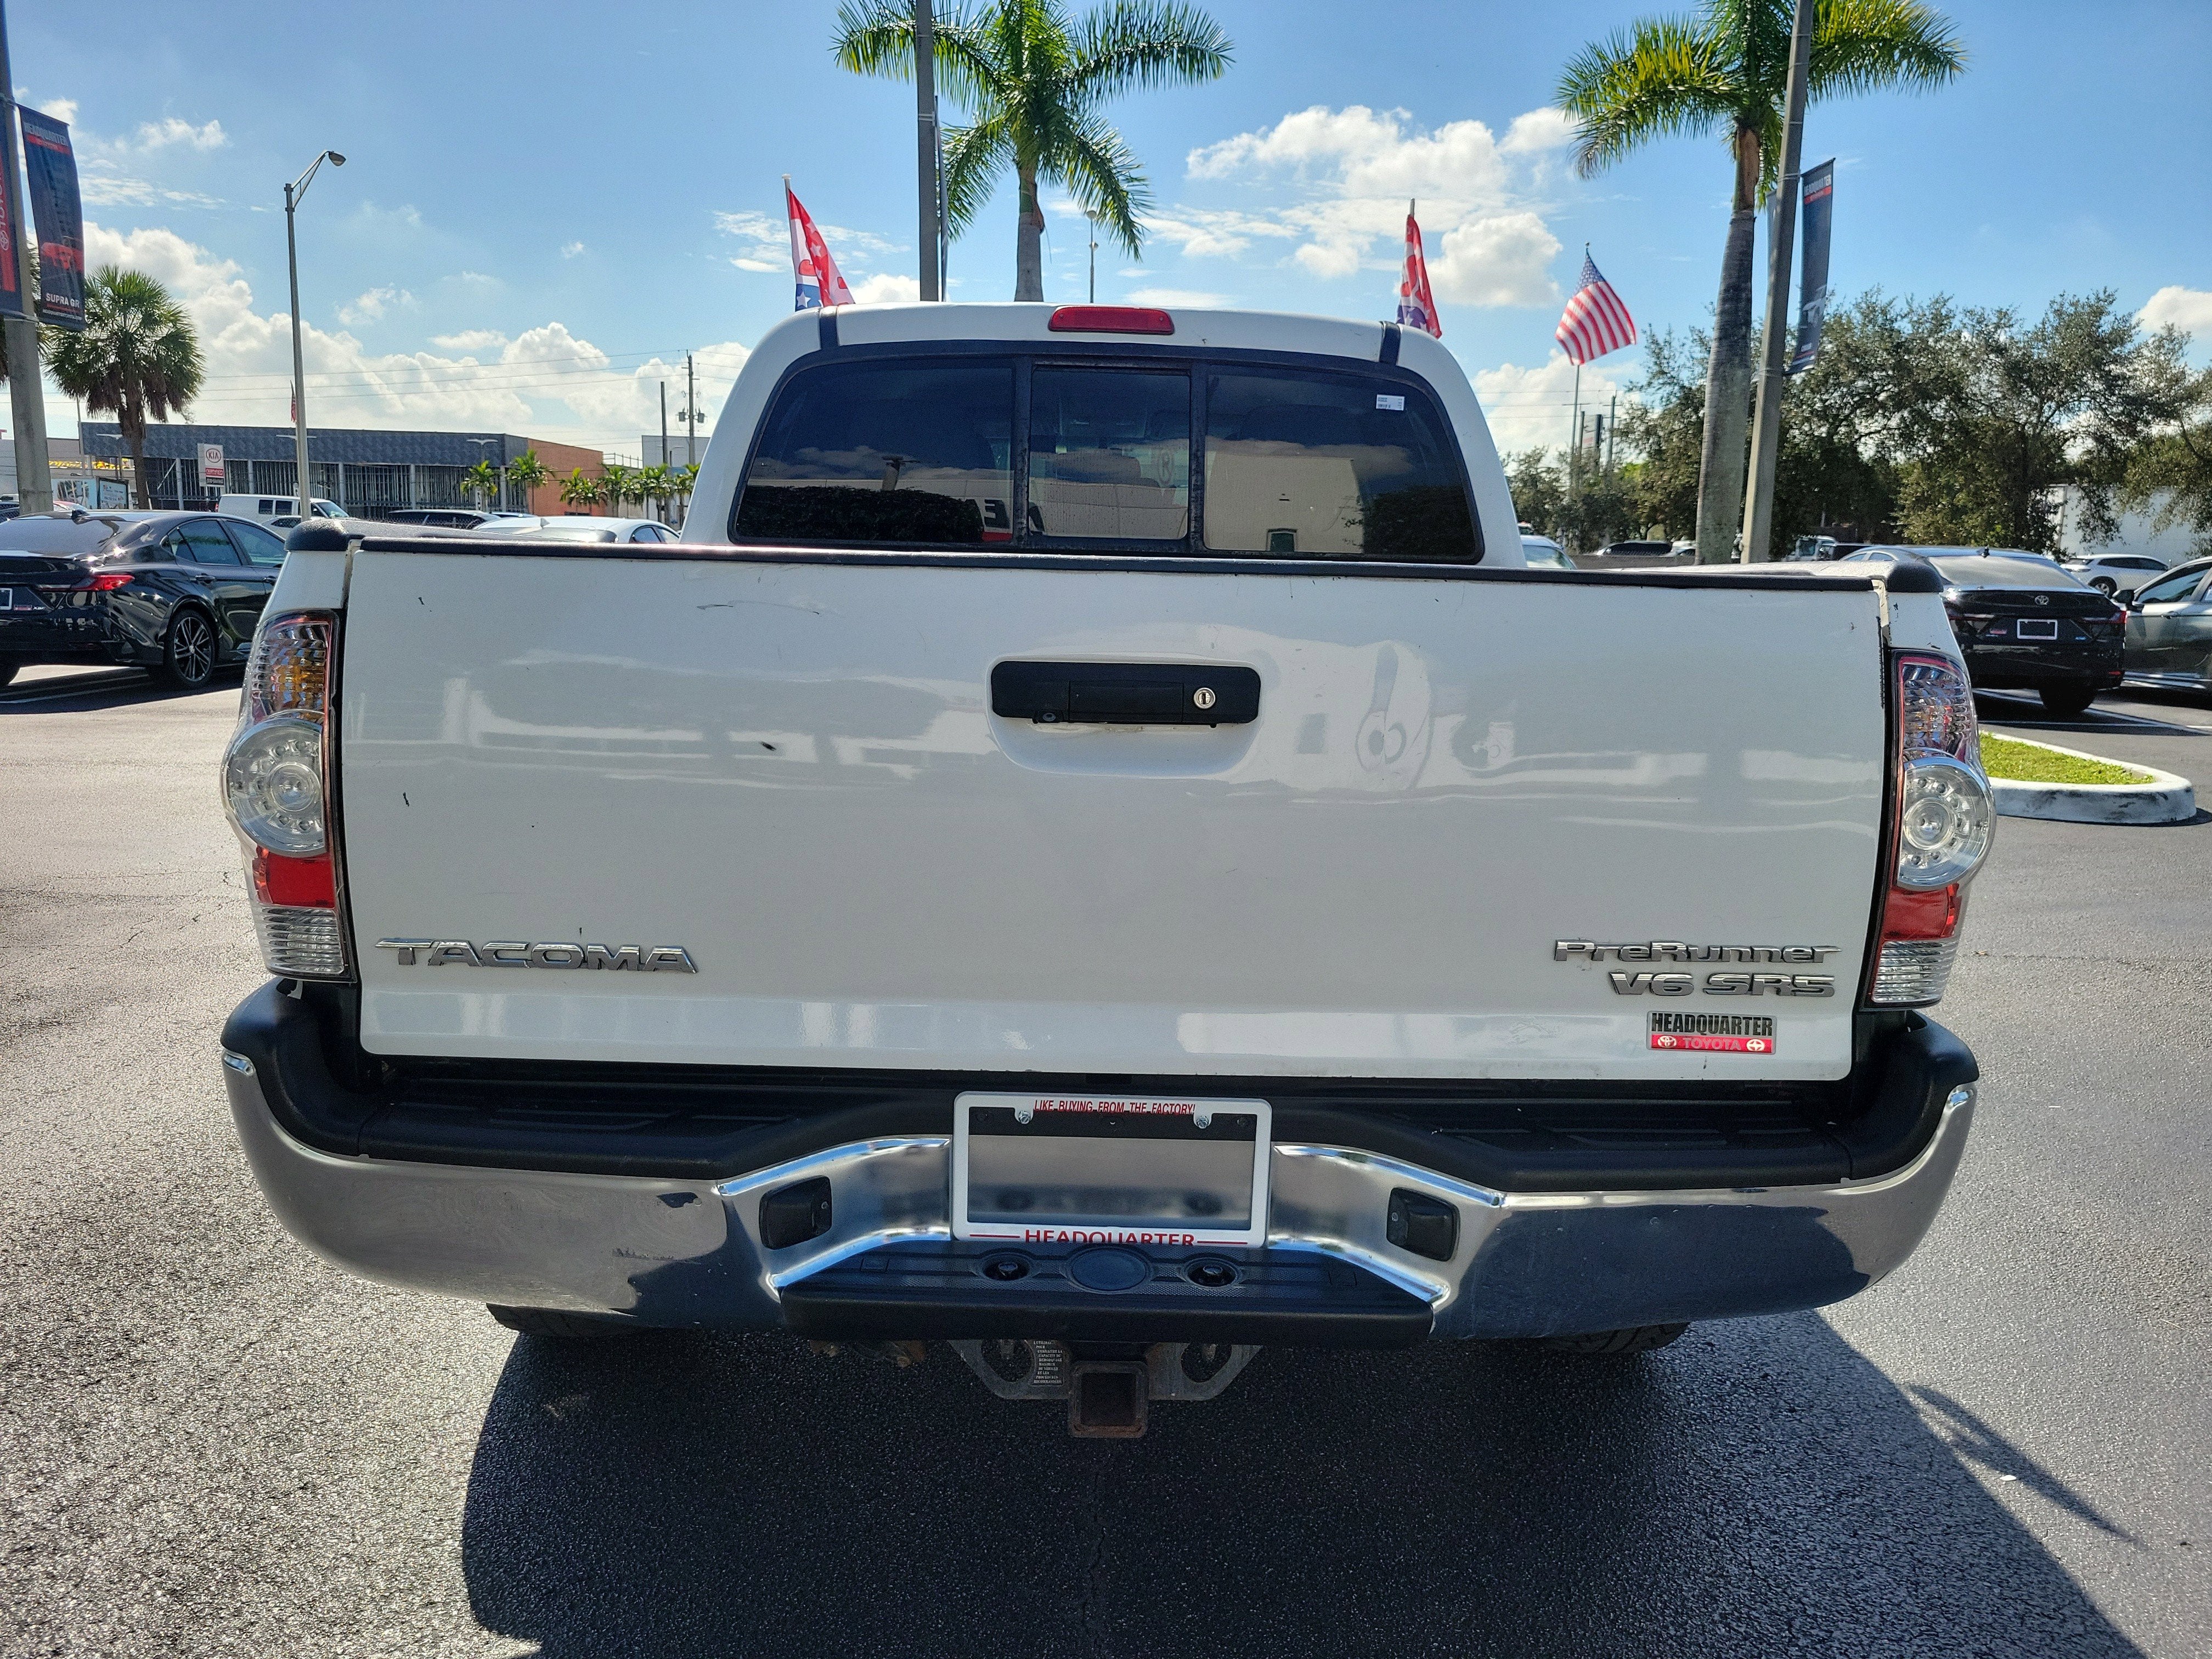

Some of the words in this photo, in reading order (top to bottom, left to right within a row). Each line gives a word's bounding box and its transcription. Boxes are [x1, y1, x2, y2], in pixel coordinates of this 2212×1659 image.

[46, 293, 70, 306] SUPRA
[70, 298, 80, 308] GR
[375, 937, 698, 973] TACOMA
[1554, 939, 1842, 963] PreRunner
[1609, 972, 1694, 996] V6
[1702, 973, 1835, 997] SR5
[1651, 1013, 1773, 1036] HEADQUARTER
[1683, 1037, 1741, 1051] TOYOTA
[1034, 1099, 1054, 1111] LIKE
[1057, 1100, 1094, 1113] BUYING
[1098, 1101, 1125, 1113] FROM
[1129, 1102, 1147, 1114] THE
[1150, 1103, 1196, 1115] FACTORY!
[1025, 1229, 1195, 1246] HEADQUARTER
